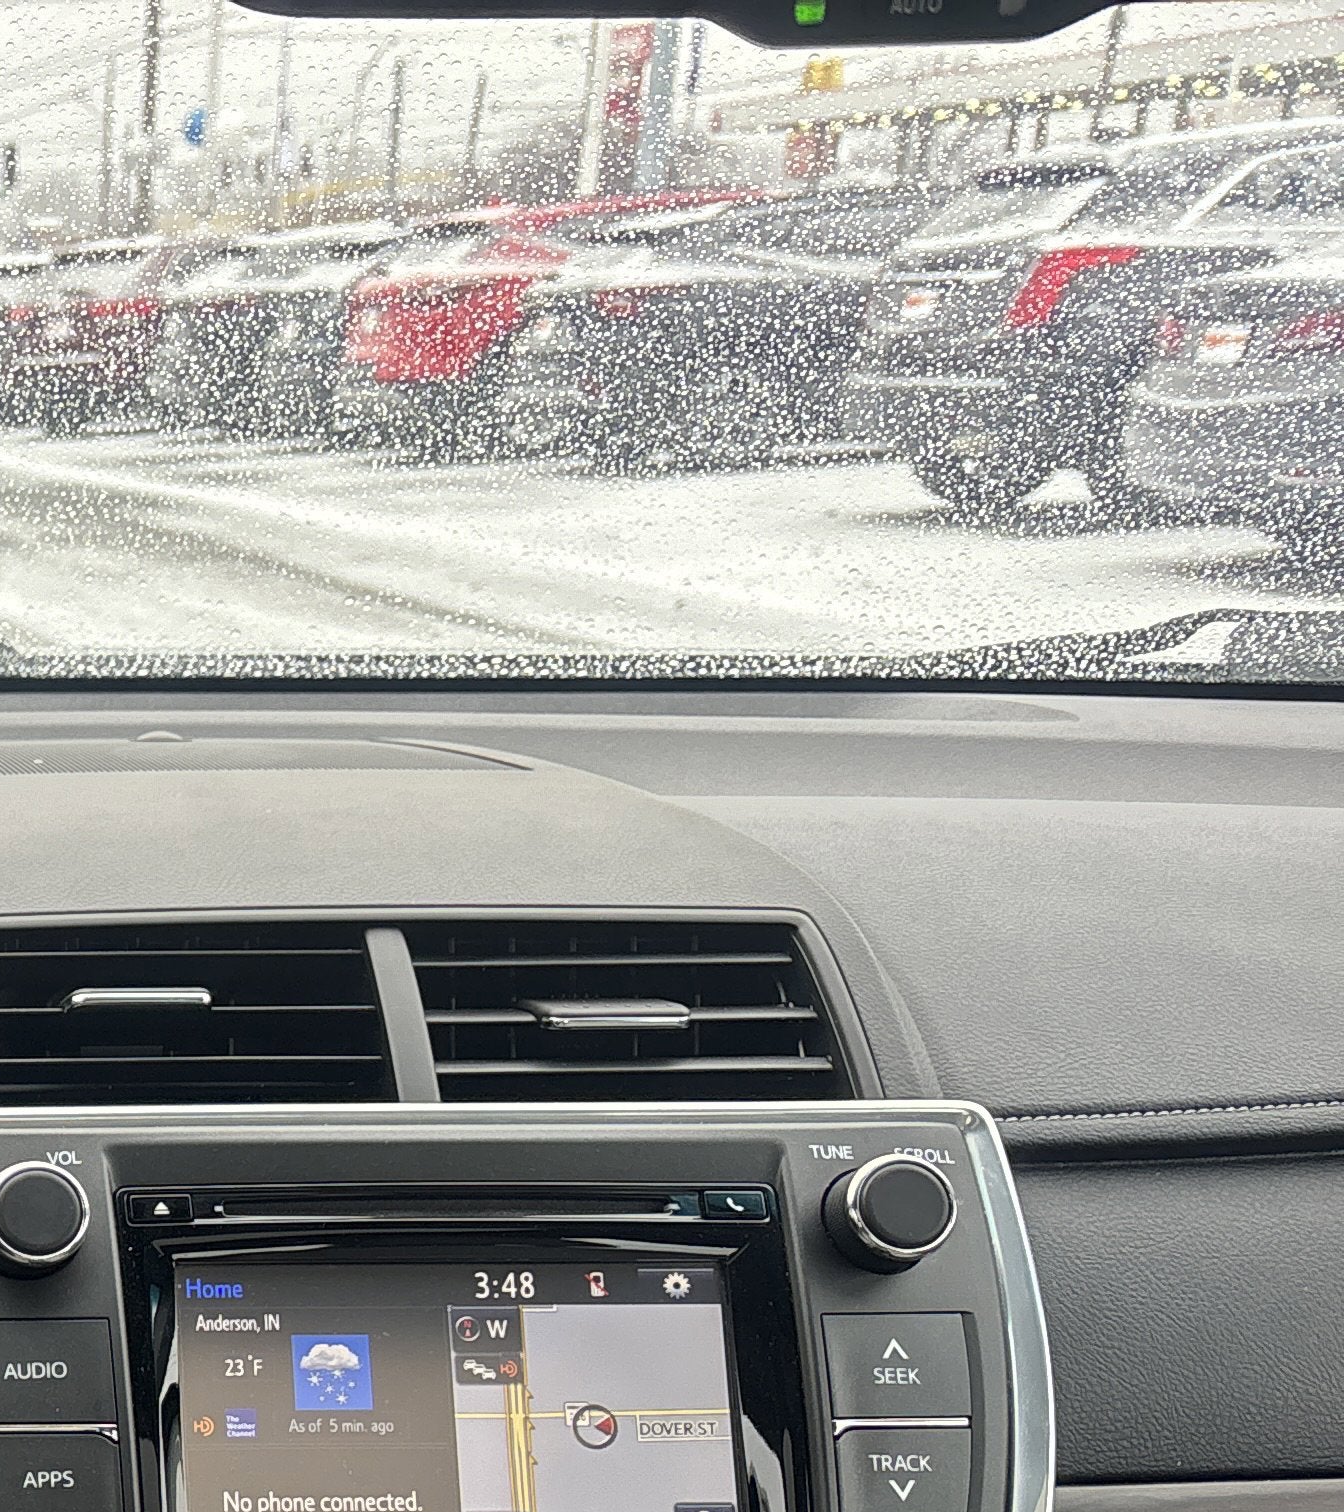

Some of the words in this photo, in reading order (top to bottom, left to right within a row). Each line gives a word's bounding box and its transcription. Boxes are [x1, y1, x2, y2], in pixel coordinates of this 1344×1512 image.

[46, 1151, 82, 1166] VOL
[808, 1144, 854, 1160] TUNE
[185, 1278, 244, 1299] Home
[474, 1271, 535, 1299] 3:48
[195, 1314, 261, 1334] Anderson,
[264, 1314, 281, 1332] IN
[486, 1319, 508, 1339] W
[3, 1361, 68, 1380] AUDIO
[873, 1367, 922, 1385] SEEK
[226, 1422, 257, 1431] Weather
[226, 1430, 256, 1439] Channel
[288, 1418, 306, 1433] As
[308, 1418, 323, 1433] of
[329, 1419, 339, 1433] 5
[341, 1418, 367, 1433] min.
[370, 1421, 395, 1436] ago
[639, 1421, 693, 1436] DOVER
[696, 1421, 717, 1436] ST
[868, 1454, 933, 1473] TRACK
[23, 1470, 75, 1489] APPS
[223, 1491, 252, 1512] No
[320, 1491, 423, 1512] connected.
